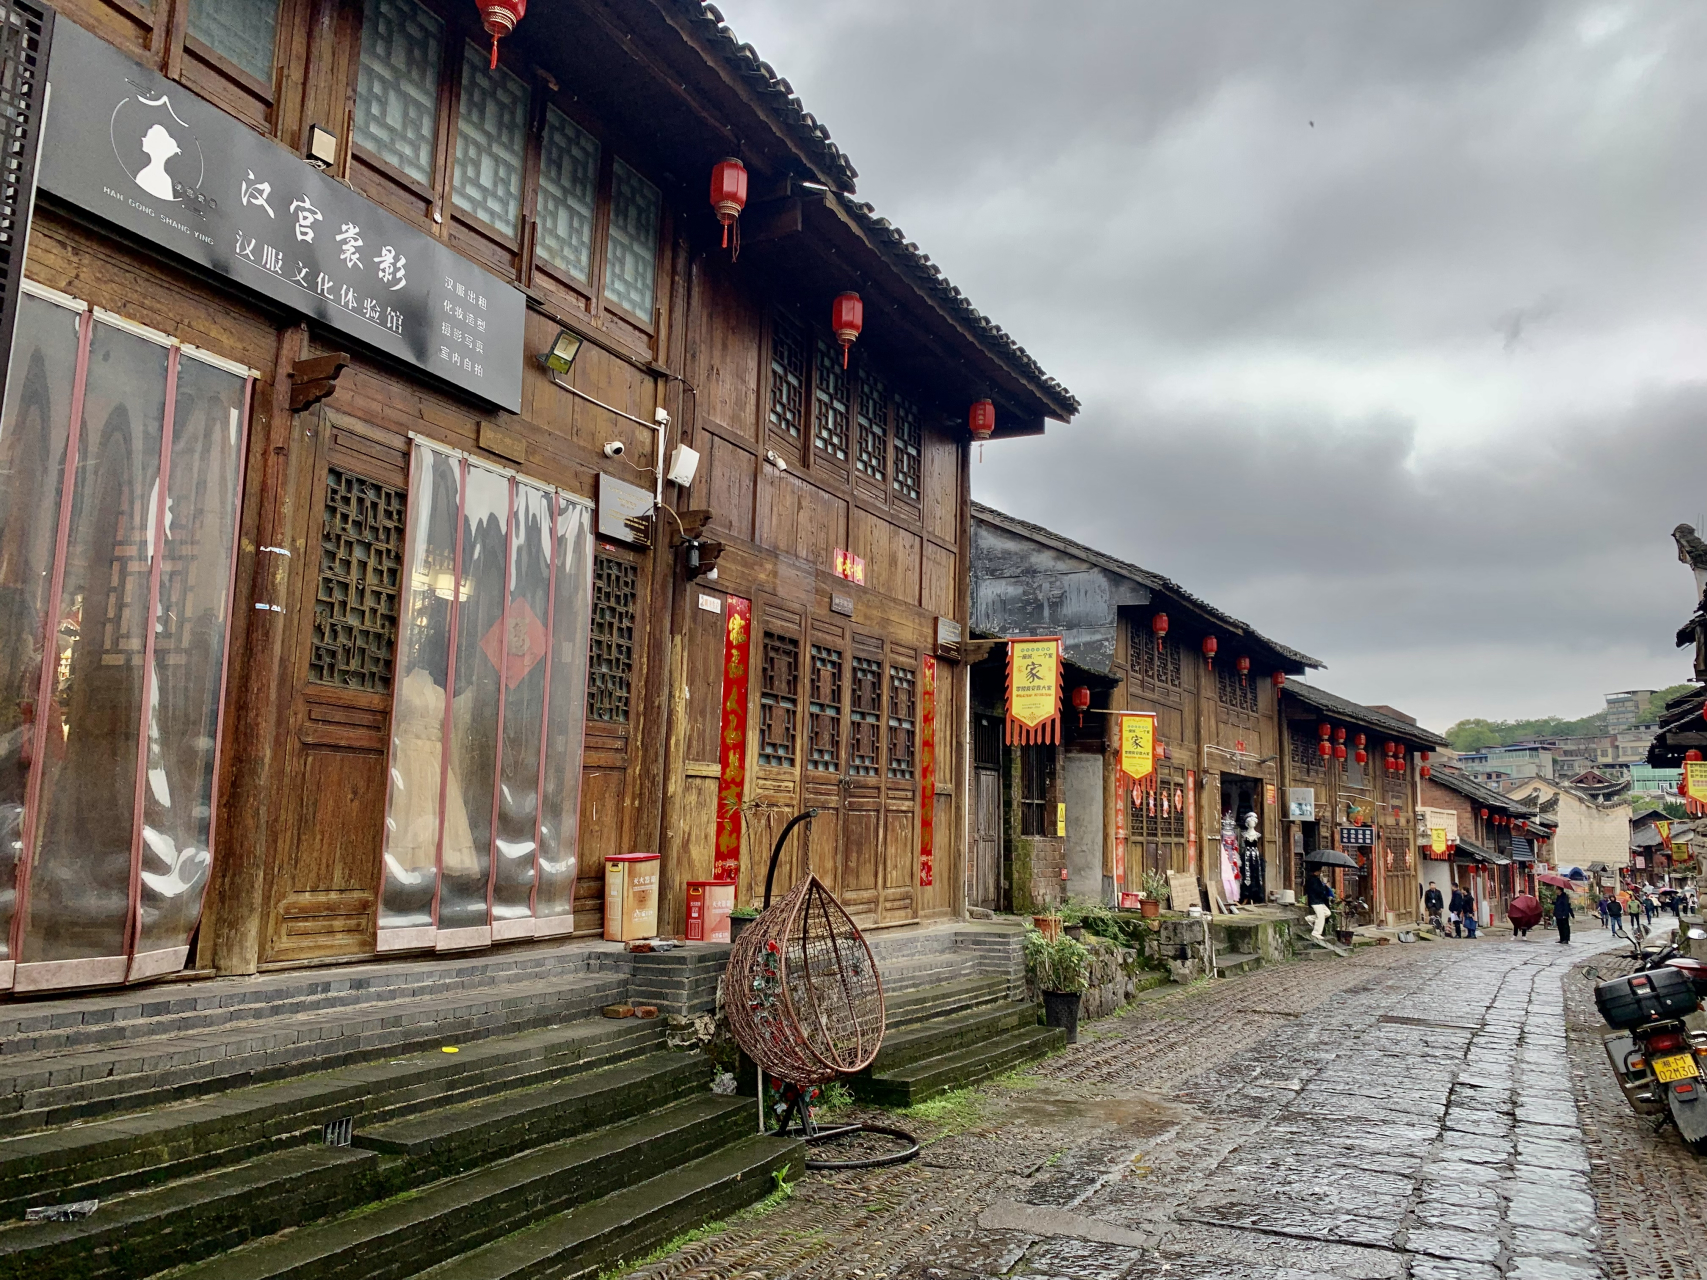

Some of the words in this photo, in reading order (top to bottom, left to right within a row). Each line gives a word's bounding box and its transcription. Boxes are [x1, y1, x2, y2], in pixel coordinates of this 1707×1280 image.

[103, 186, 124, 201] HAN
[128, 198, 155, 217] GONG
[160, 214, 191, 234] SHANG
[194, 230, 214, 245] YING
[241, 169, 407, 291] 汉宫裳影
[235, 229, 404, 334] 汉服文化体验馆
[444, 276, 487, 311] 汉服出租
[443, 299, 486, 333] 化妆造型
[441, 321, 484, 355] 摄影写真
[439, 345, 483, 378] 室内自拍
[1025, 661, 1043, 684] 家
[1659, 1064, 1696, 1081] 02M30
